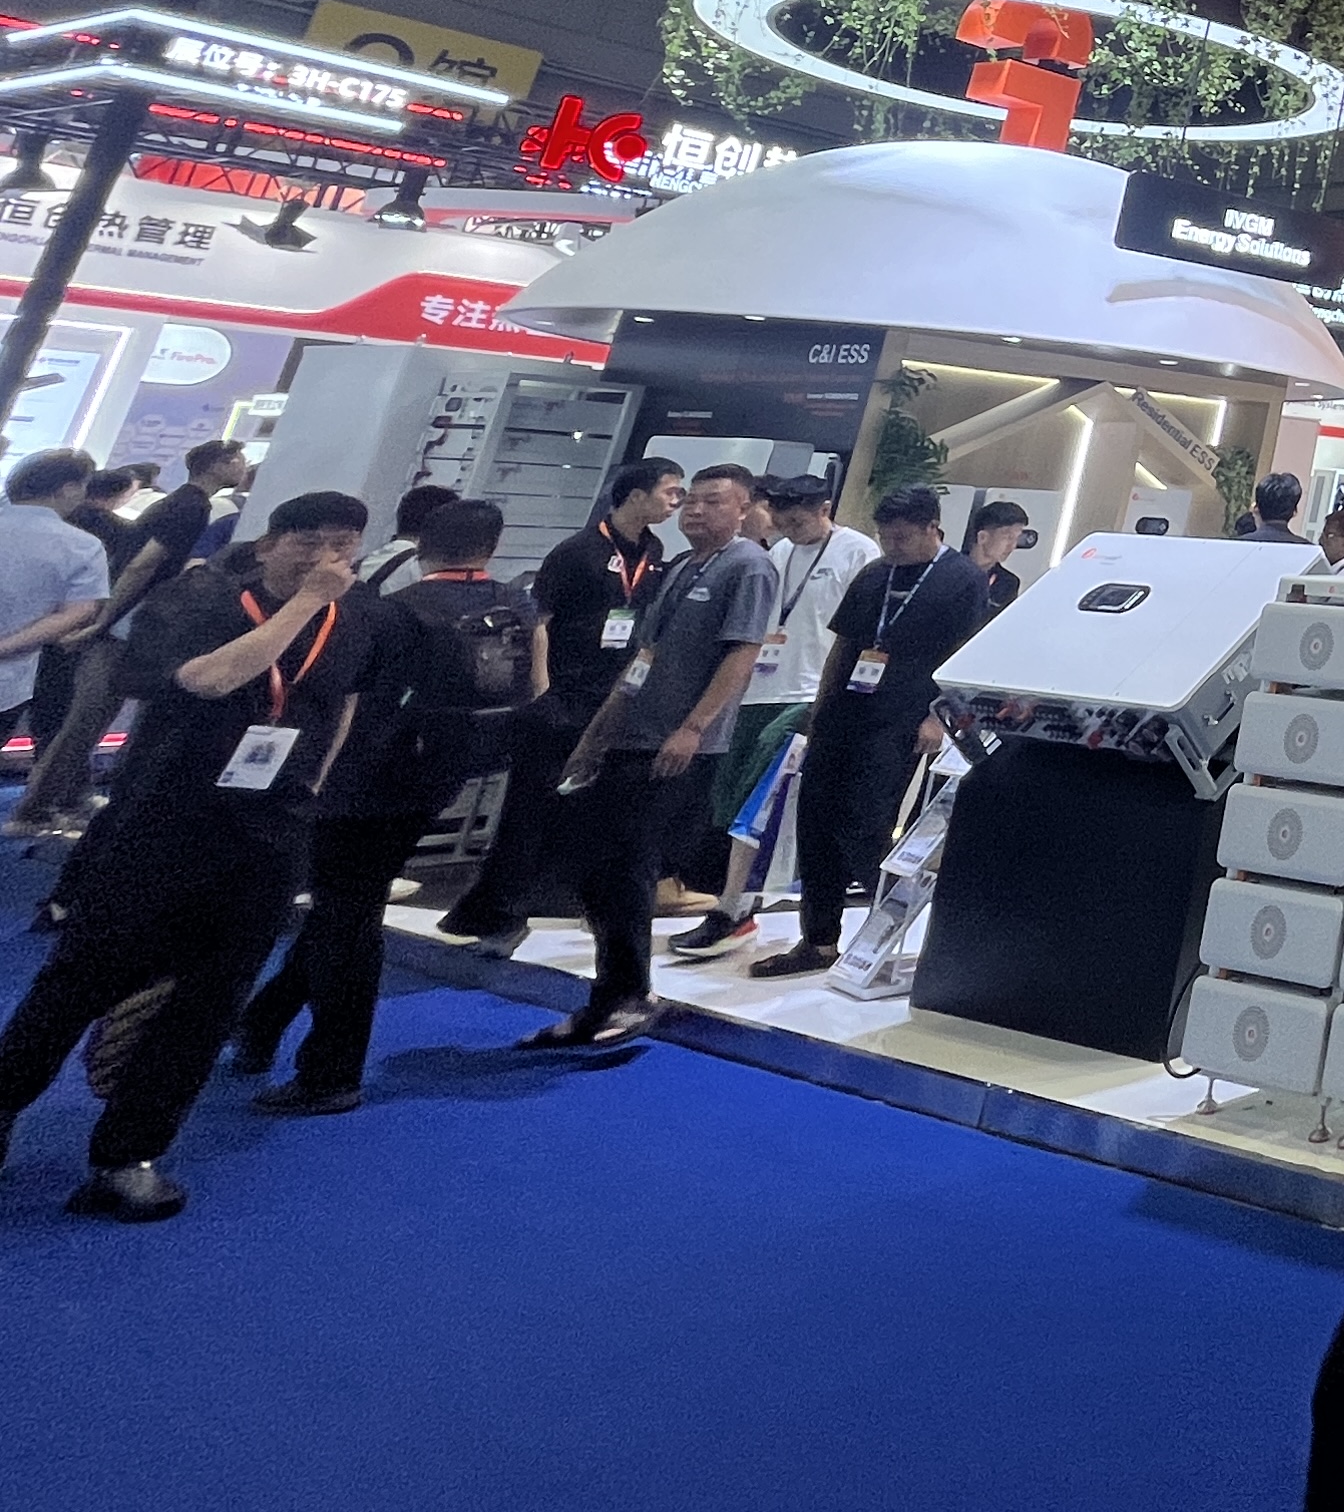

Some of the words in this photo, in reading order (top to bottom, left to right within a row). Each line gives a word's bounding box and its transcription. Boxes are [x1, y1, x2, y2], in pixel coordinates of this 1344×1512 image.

[1172, 218, 1237, 254] Energy
[1235, 234, 1312, 267] Solutions
[808, 344, 835, 364] C&I
[837, 344, 870, 365] ESS
[1131, 390, 1191, 450] Residential
[1189, 445, 1216, 472] ESS
